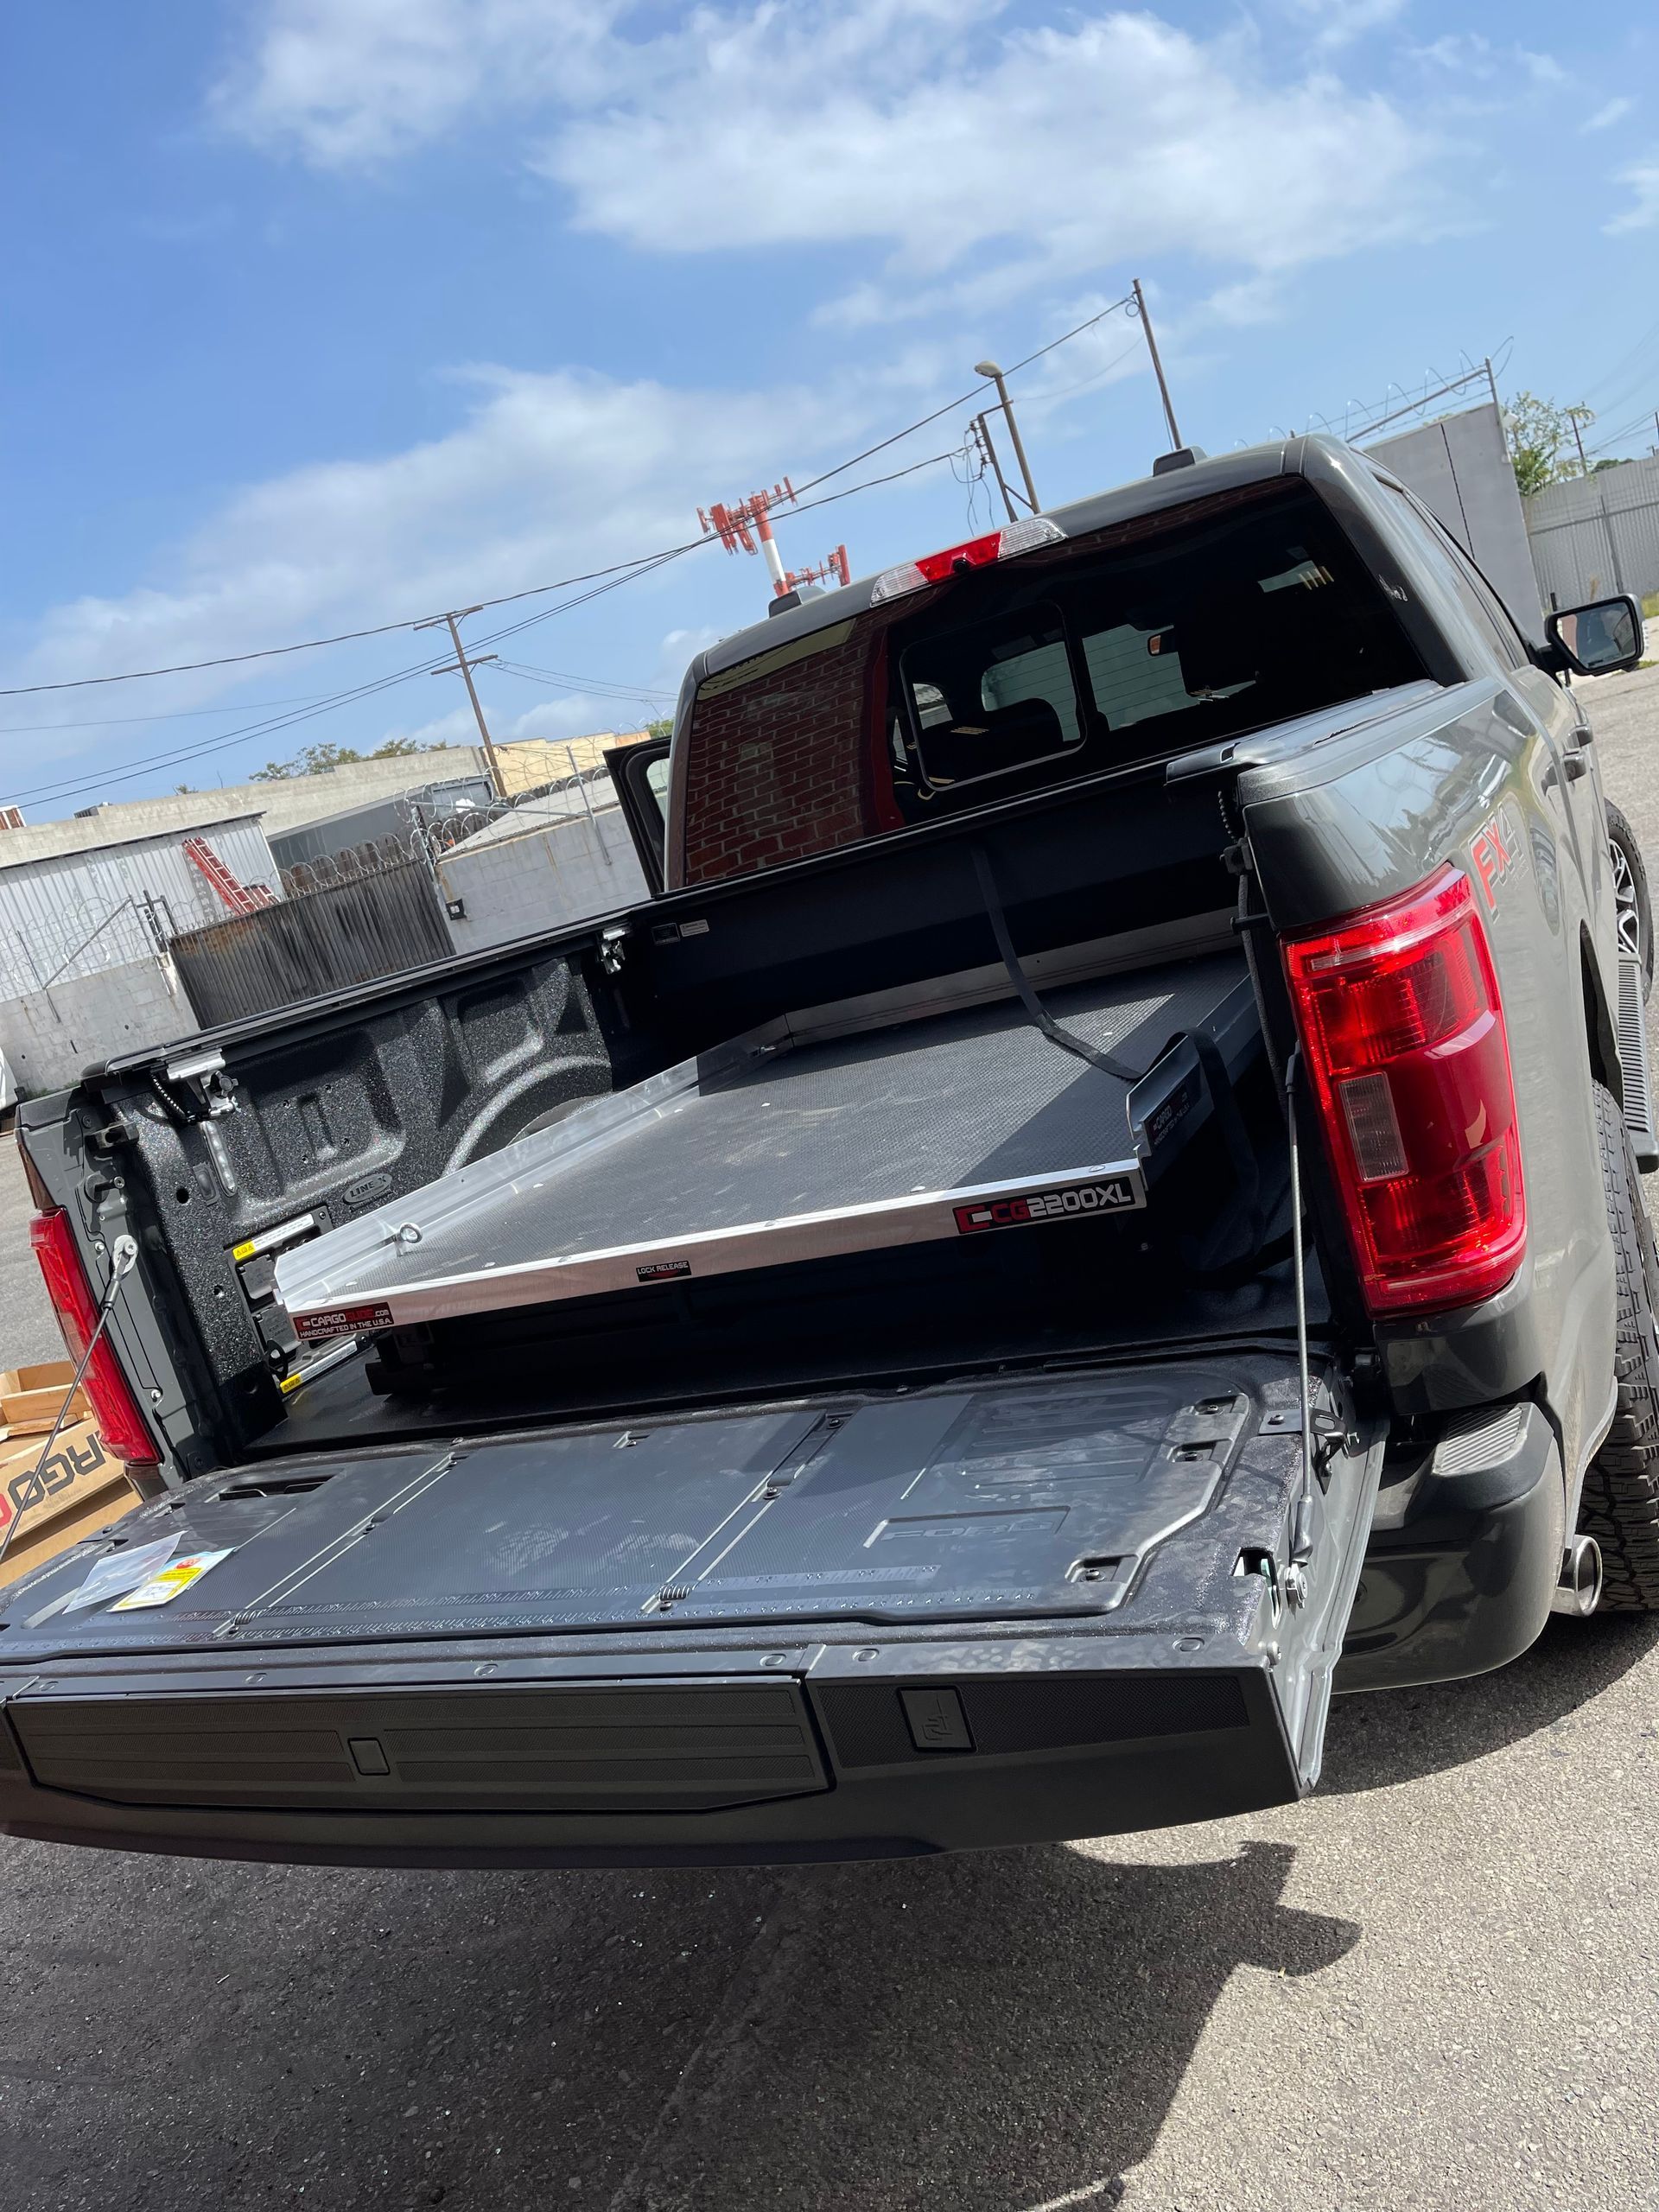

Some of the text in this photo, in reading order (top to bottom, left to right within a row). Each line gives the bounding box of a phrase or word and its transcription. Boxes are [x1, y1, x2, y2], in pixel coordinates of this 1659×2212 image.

[1471, 806, 1521, 919] FX4
[991, 1183, 1131, 1224] CG2200XL
[637, 1262, 689, 1274] LOCK RELEASE
[299, 1325, 349, 1338] HANDCRAFTED
[880, 1518, 1054, 1541] FORD
